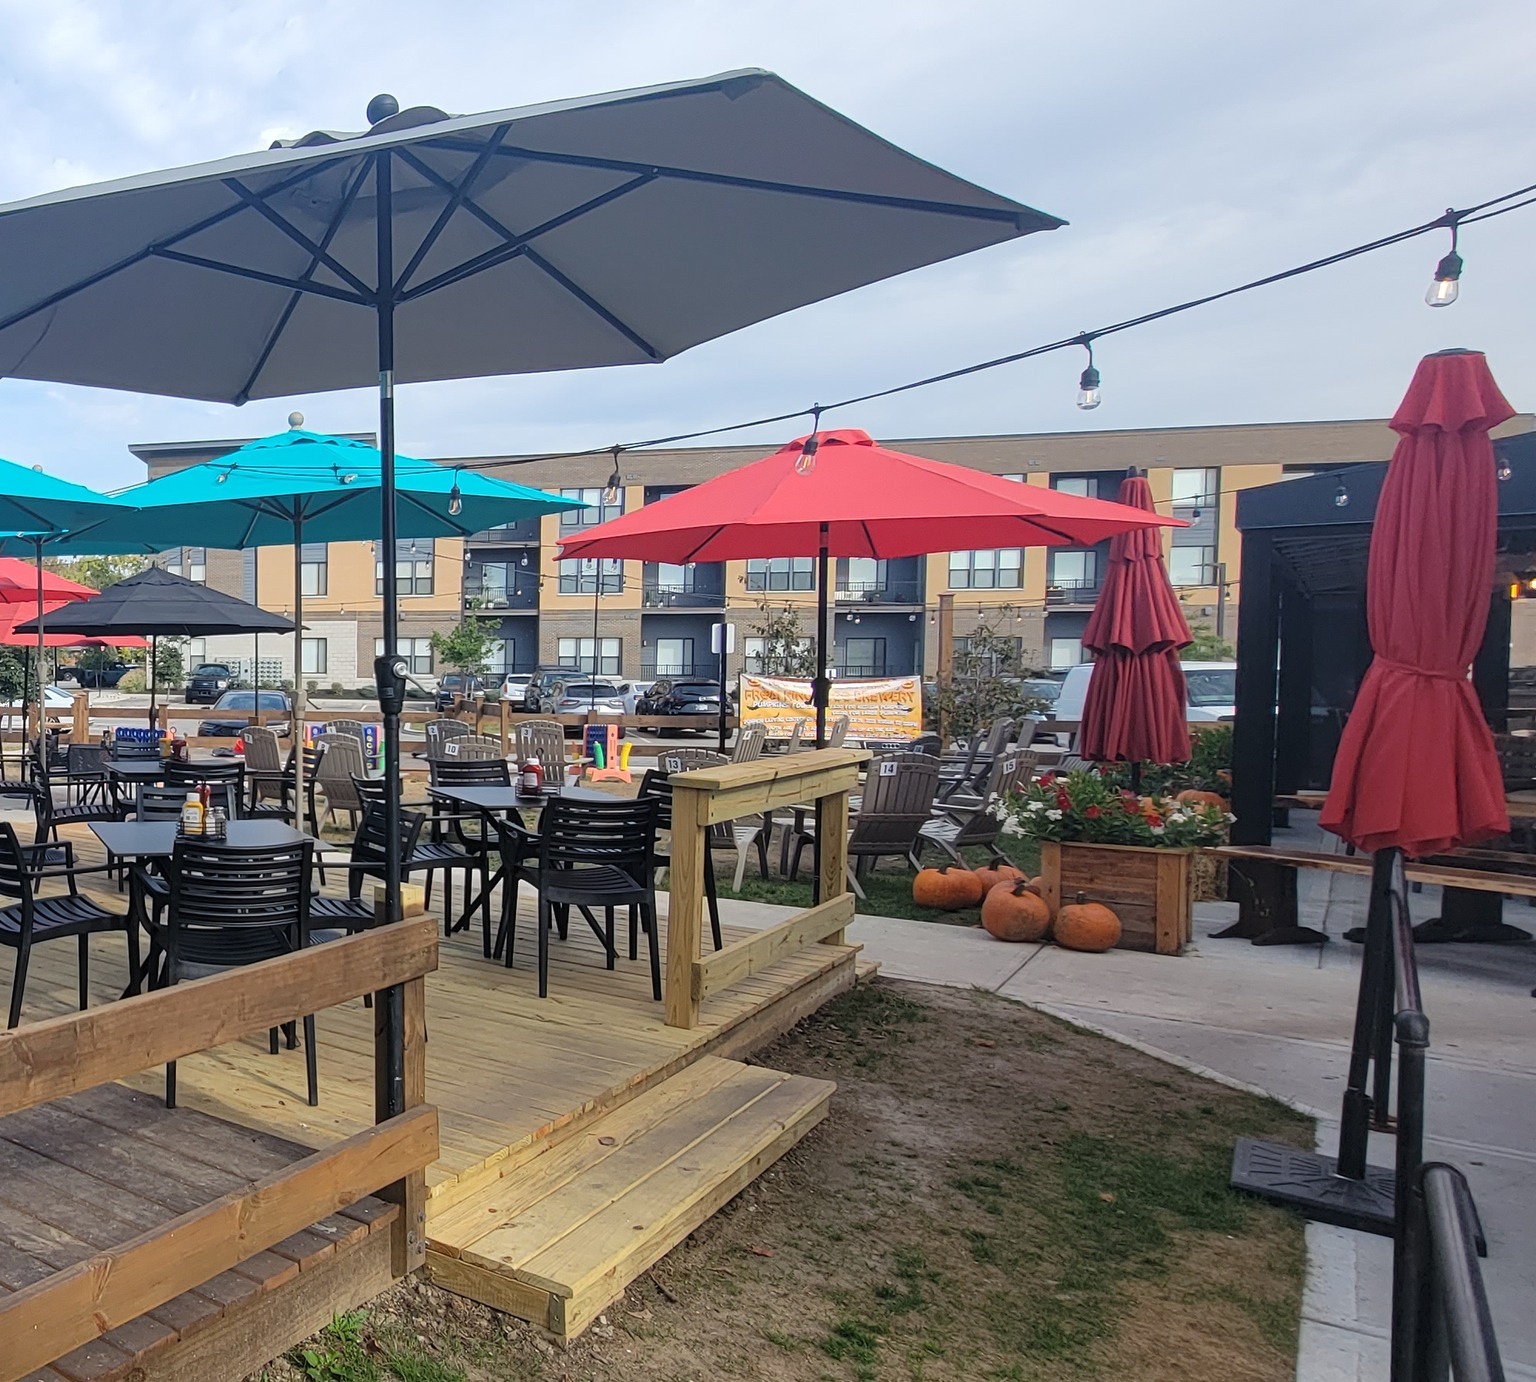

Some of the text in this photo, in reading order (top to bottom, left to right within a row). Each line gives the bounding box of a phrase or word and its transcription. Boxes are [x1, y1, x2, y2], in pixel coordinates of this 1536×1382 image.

[854, 690, 915, 703] BREWERY
[447, 745, 456, 754] 10
[668, 760, 679, 769] 13
[883, 764, 894, 774] 14
[1005, 761, 1014, 771] 15
